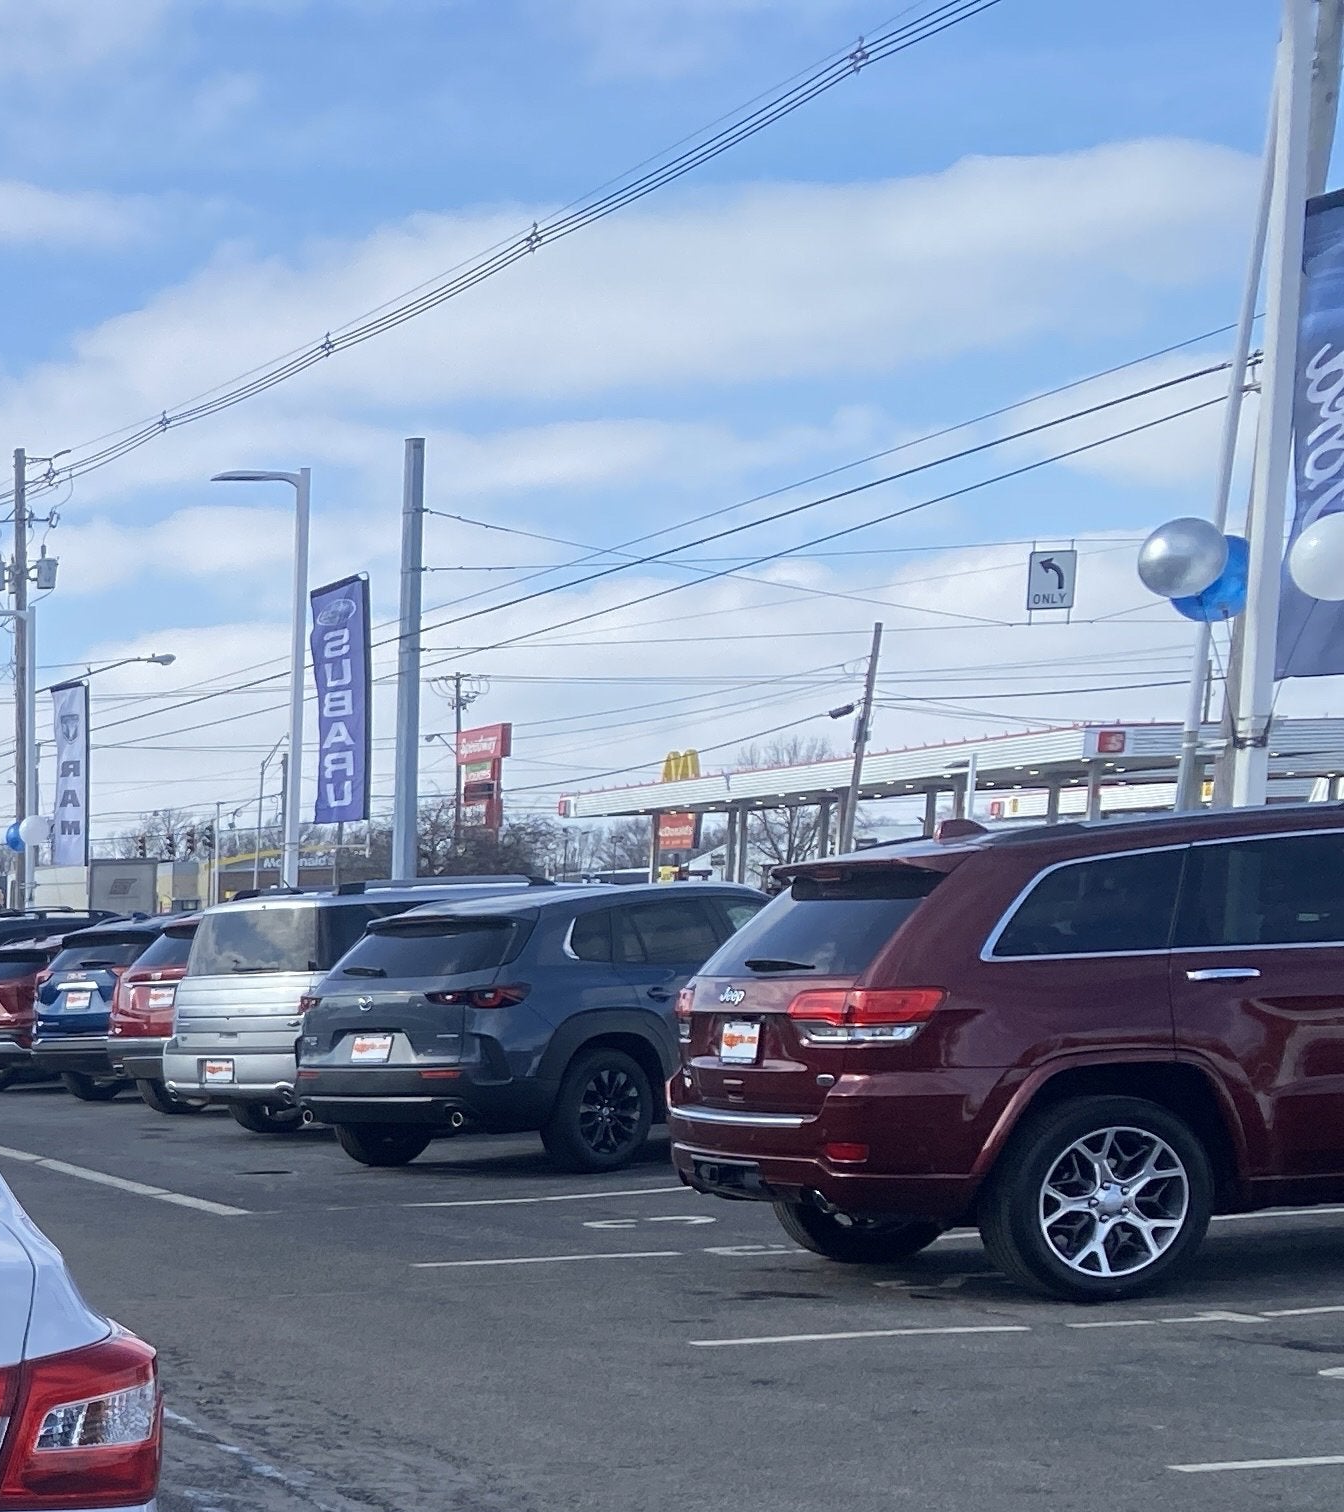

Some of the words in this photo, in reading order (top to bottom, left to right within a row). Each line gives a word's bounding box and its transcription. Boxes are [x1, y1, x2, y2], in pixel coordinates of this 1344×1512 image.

[1033, 592, 1067, 605] ONLY
[263, 855, 335, 869] Mcnald's
[720, 986, 746, 1006] Jeep
